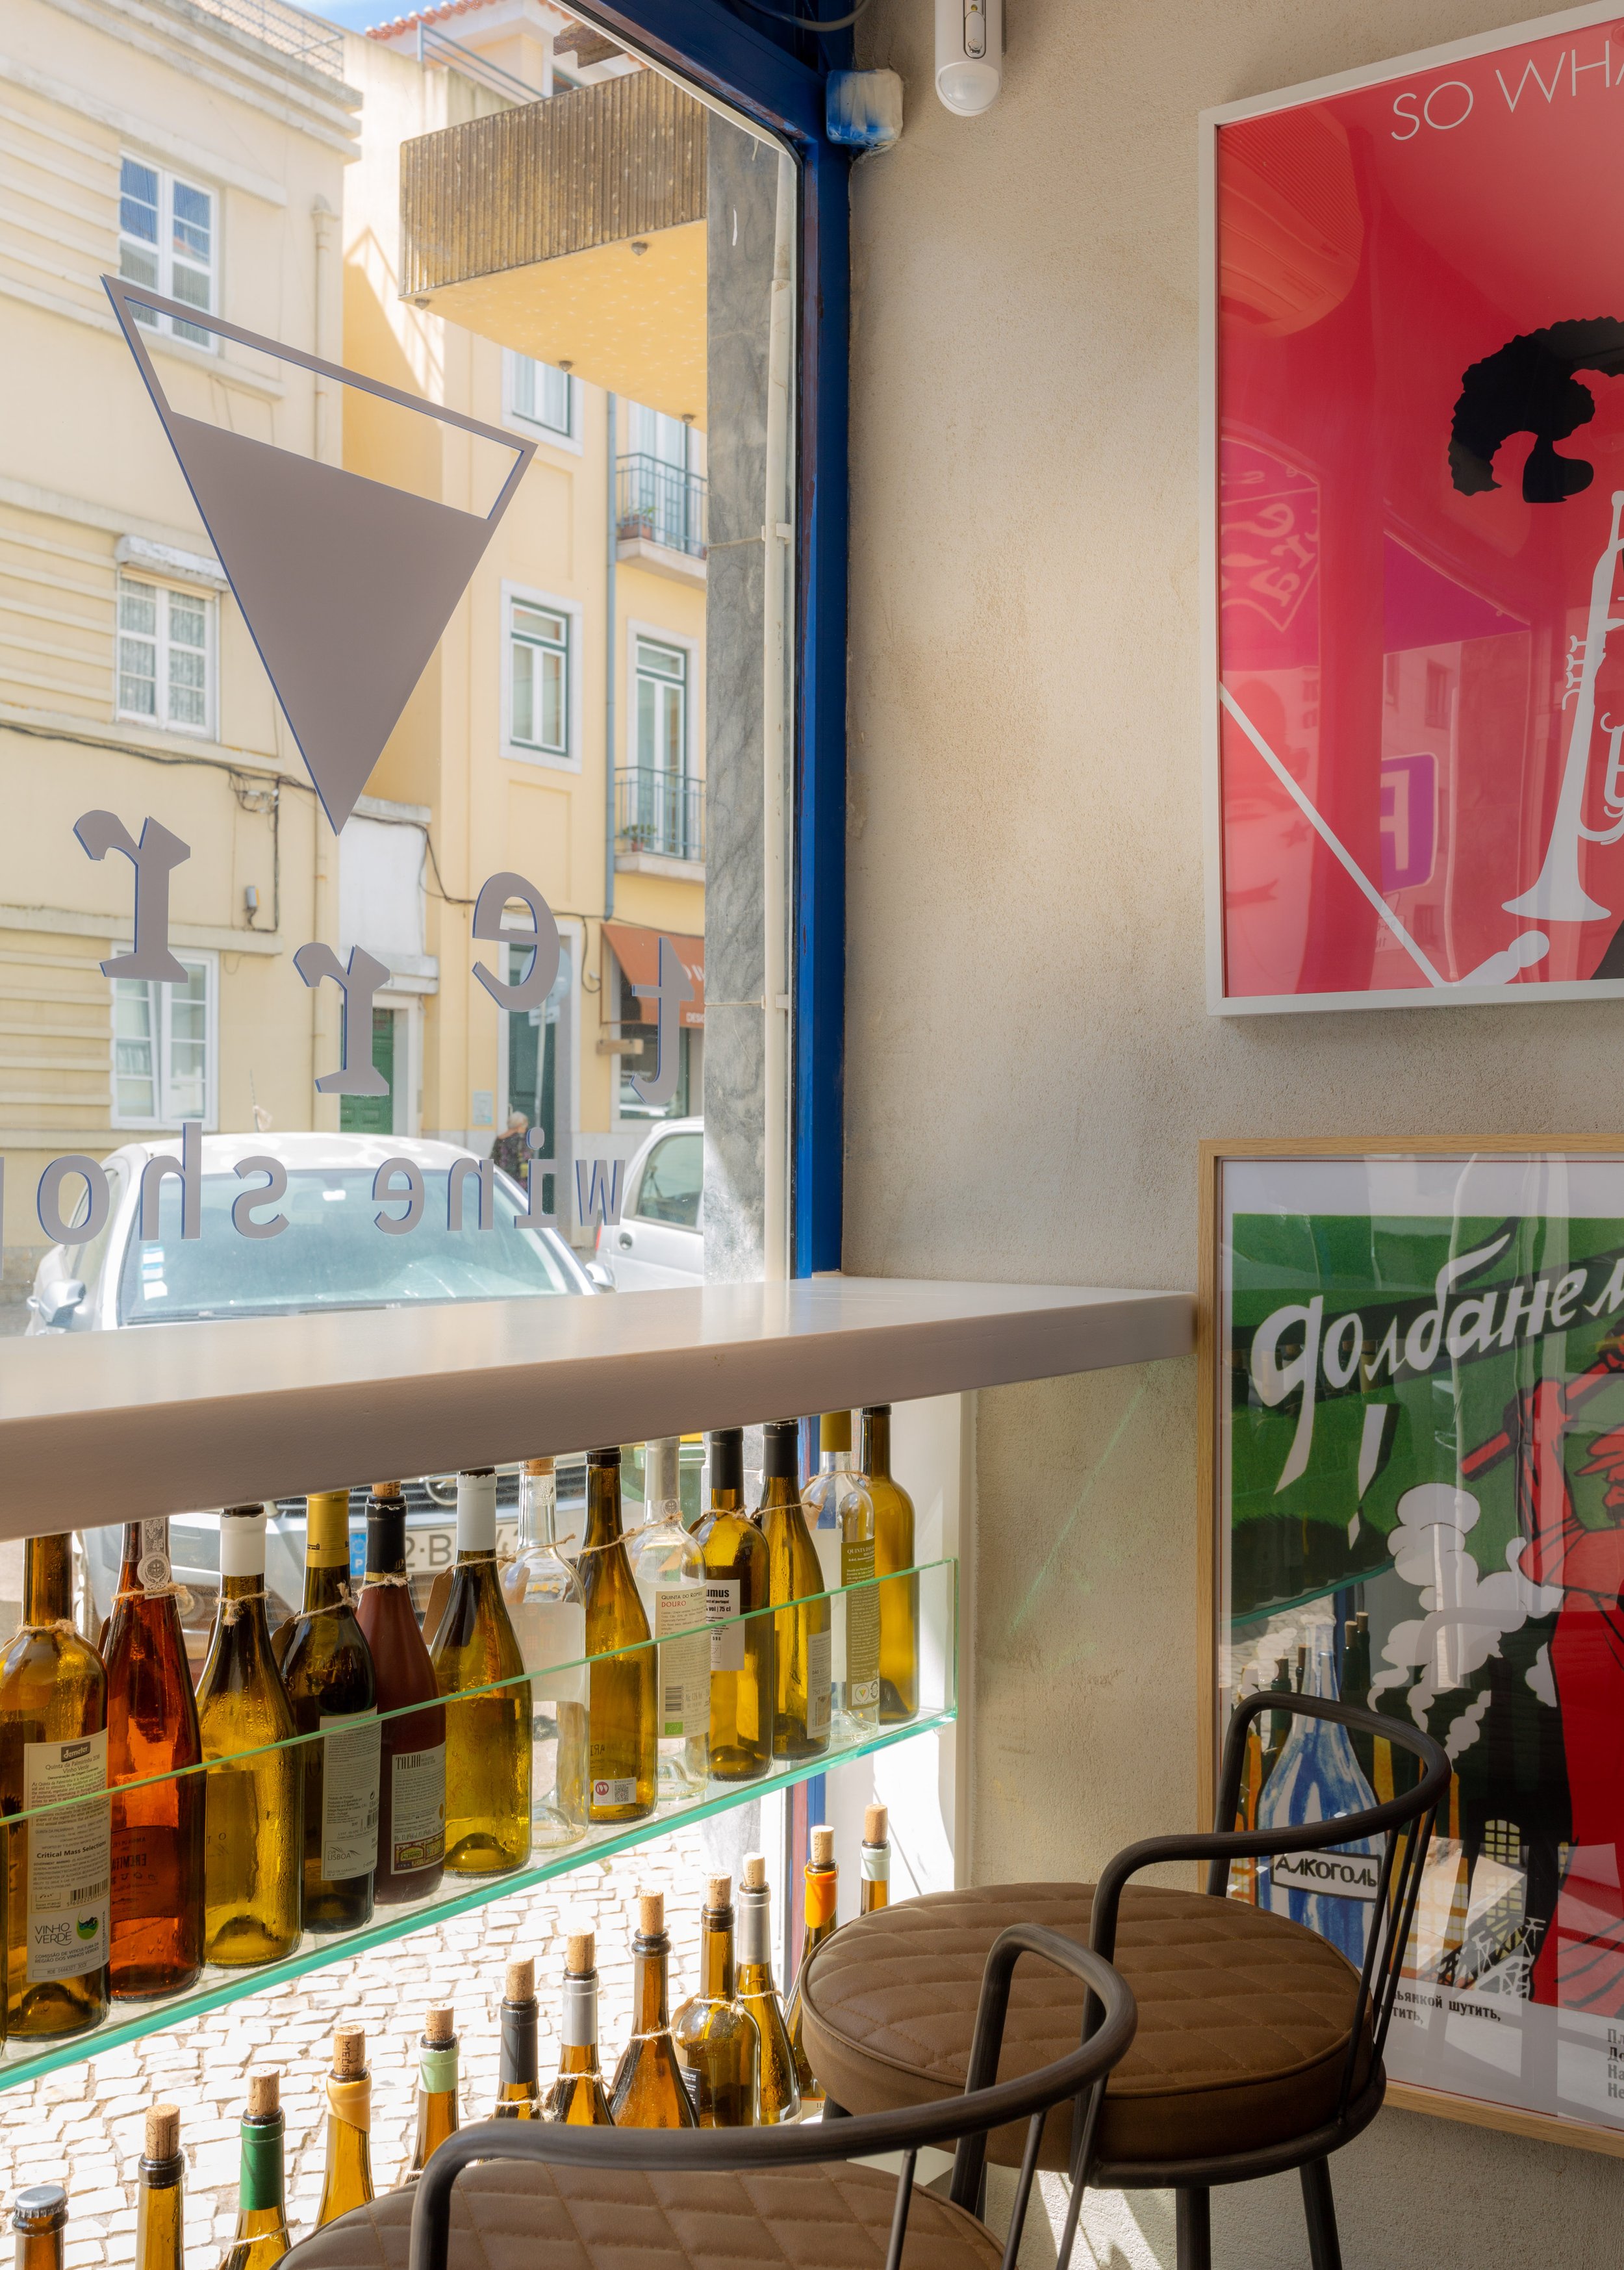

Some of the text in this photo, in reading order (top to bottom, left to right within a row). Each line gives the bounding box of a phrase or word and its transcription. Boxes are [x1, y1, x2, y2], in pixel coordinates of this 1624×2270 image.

[1391, 40, 1624, 140] SO WH
[63, 1746, 88, 1758] demeter
[82, 1840, 107, 1852] Selections
[1275, 1855, 1378, 1887] АЛКОГОЛЬ
[35, 1922, 70, 1935] VINHO
[35, 1931, 72, 1946] VERDE
[1394, 1990, 1501, 2021] ьянкой шутить,
[1392, 2007, 1423, 2024] тить,
[342, 2041, 351, 2077] MELIS
